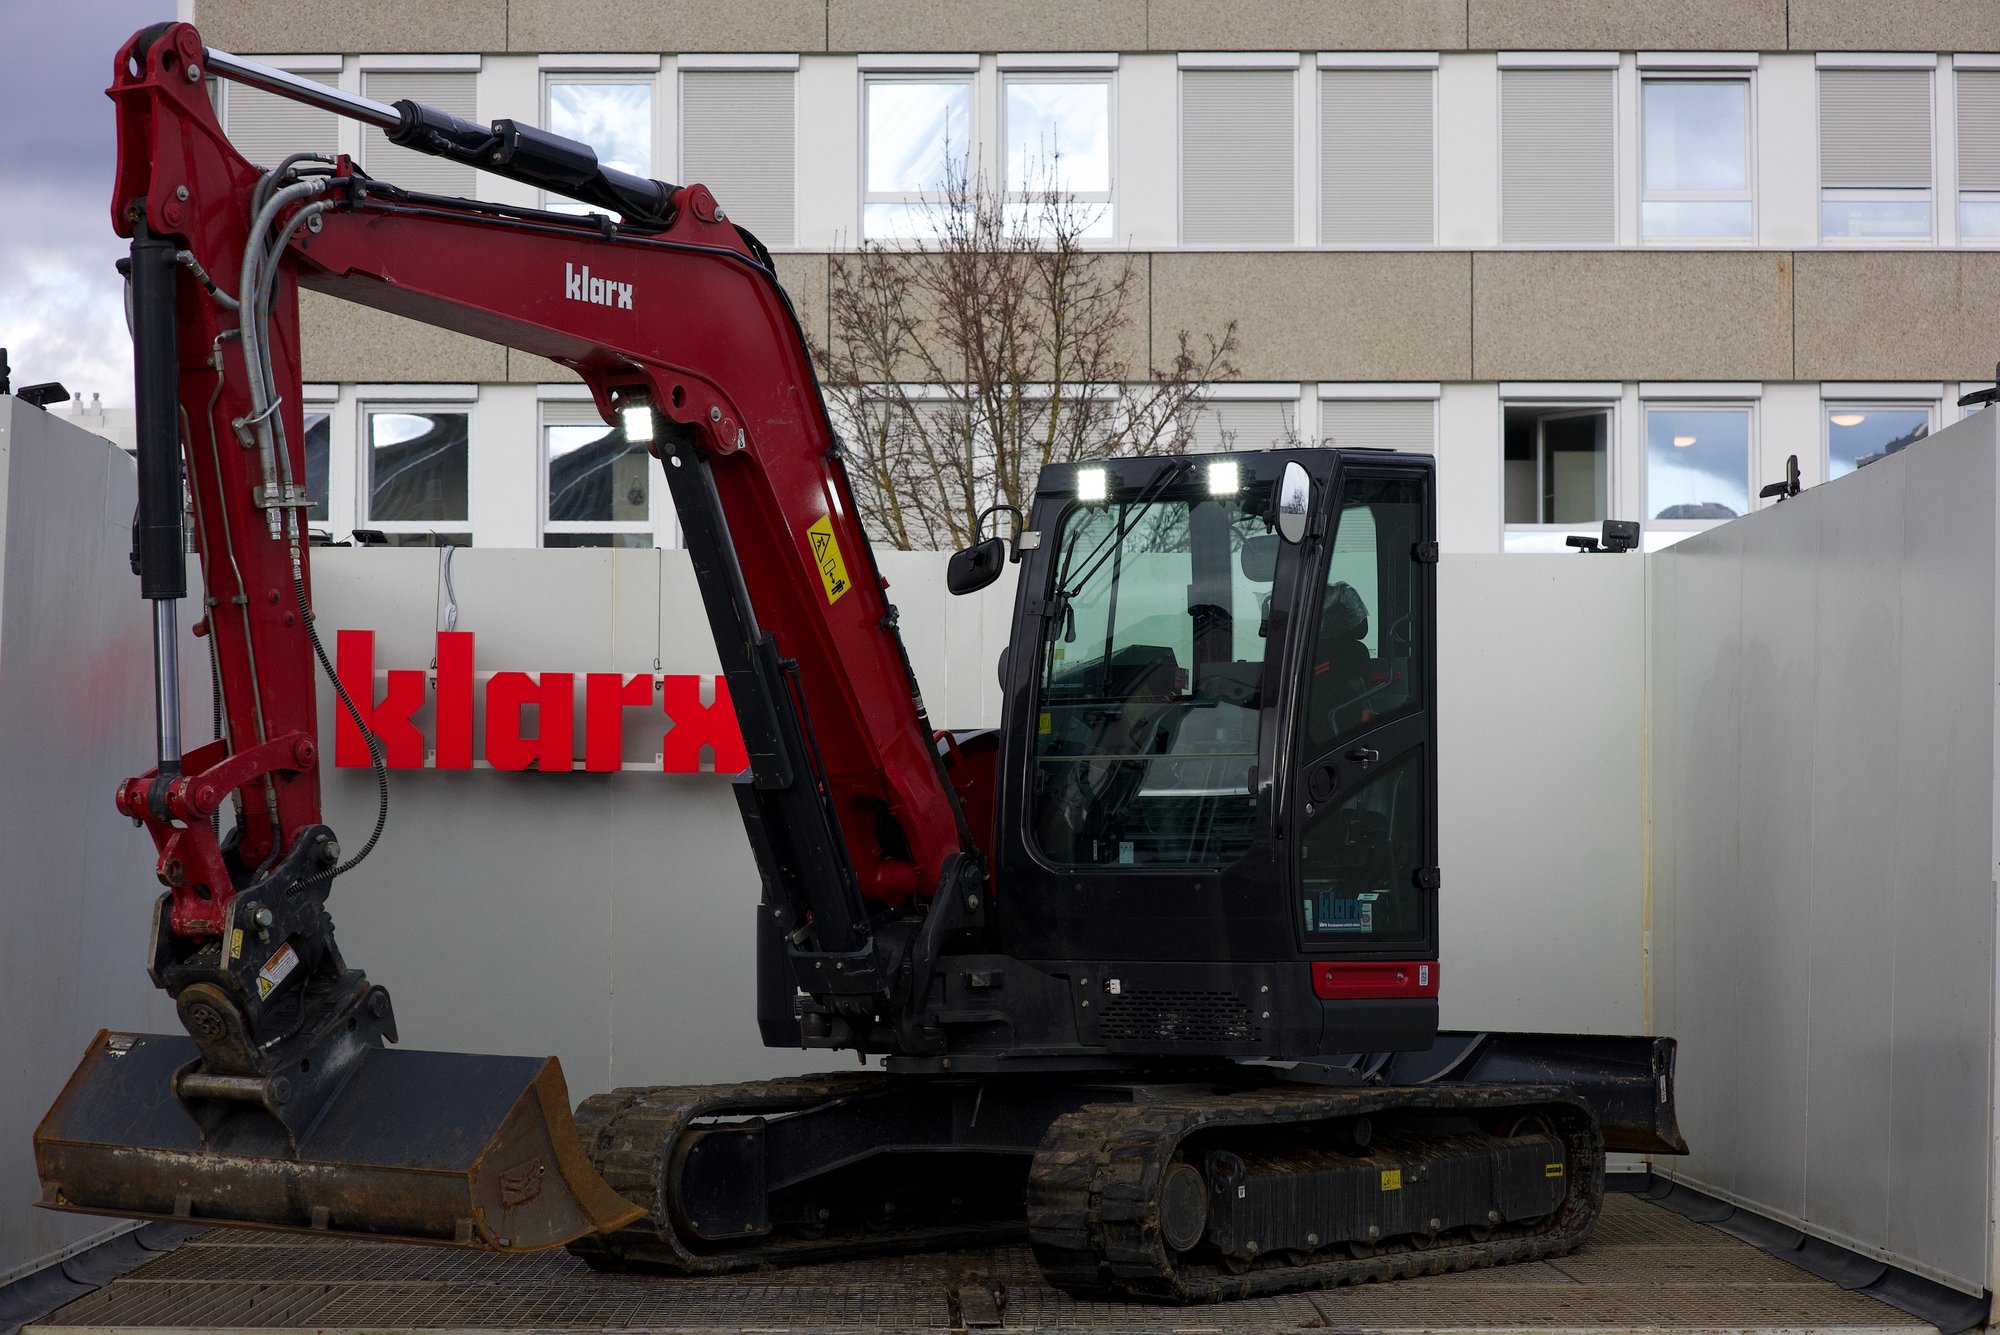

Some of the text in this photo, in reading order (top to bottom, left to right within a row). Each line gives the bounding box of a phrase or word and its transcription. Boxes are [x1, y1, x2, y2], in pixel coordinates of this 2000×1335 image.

[565, 262, 633, 310] klarx
[335, 630, 750, 774] klarx
[1320, 891, 1362, 919] klarx
